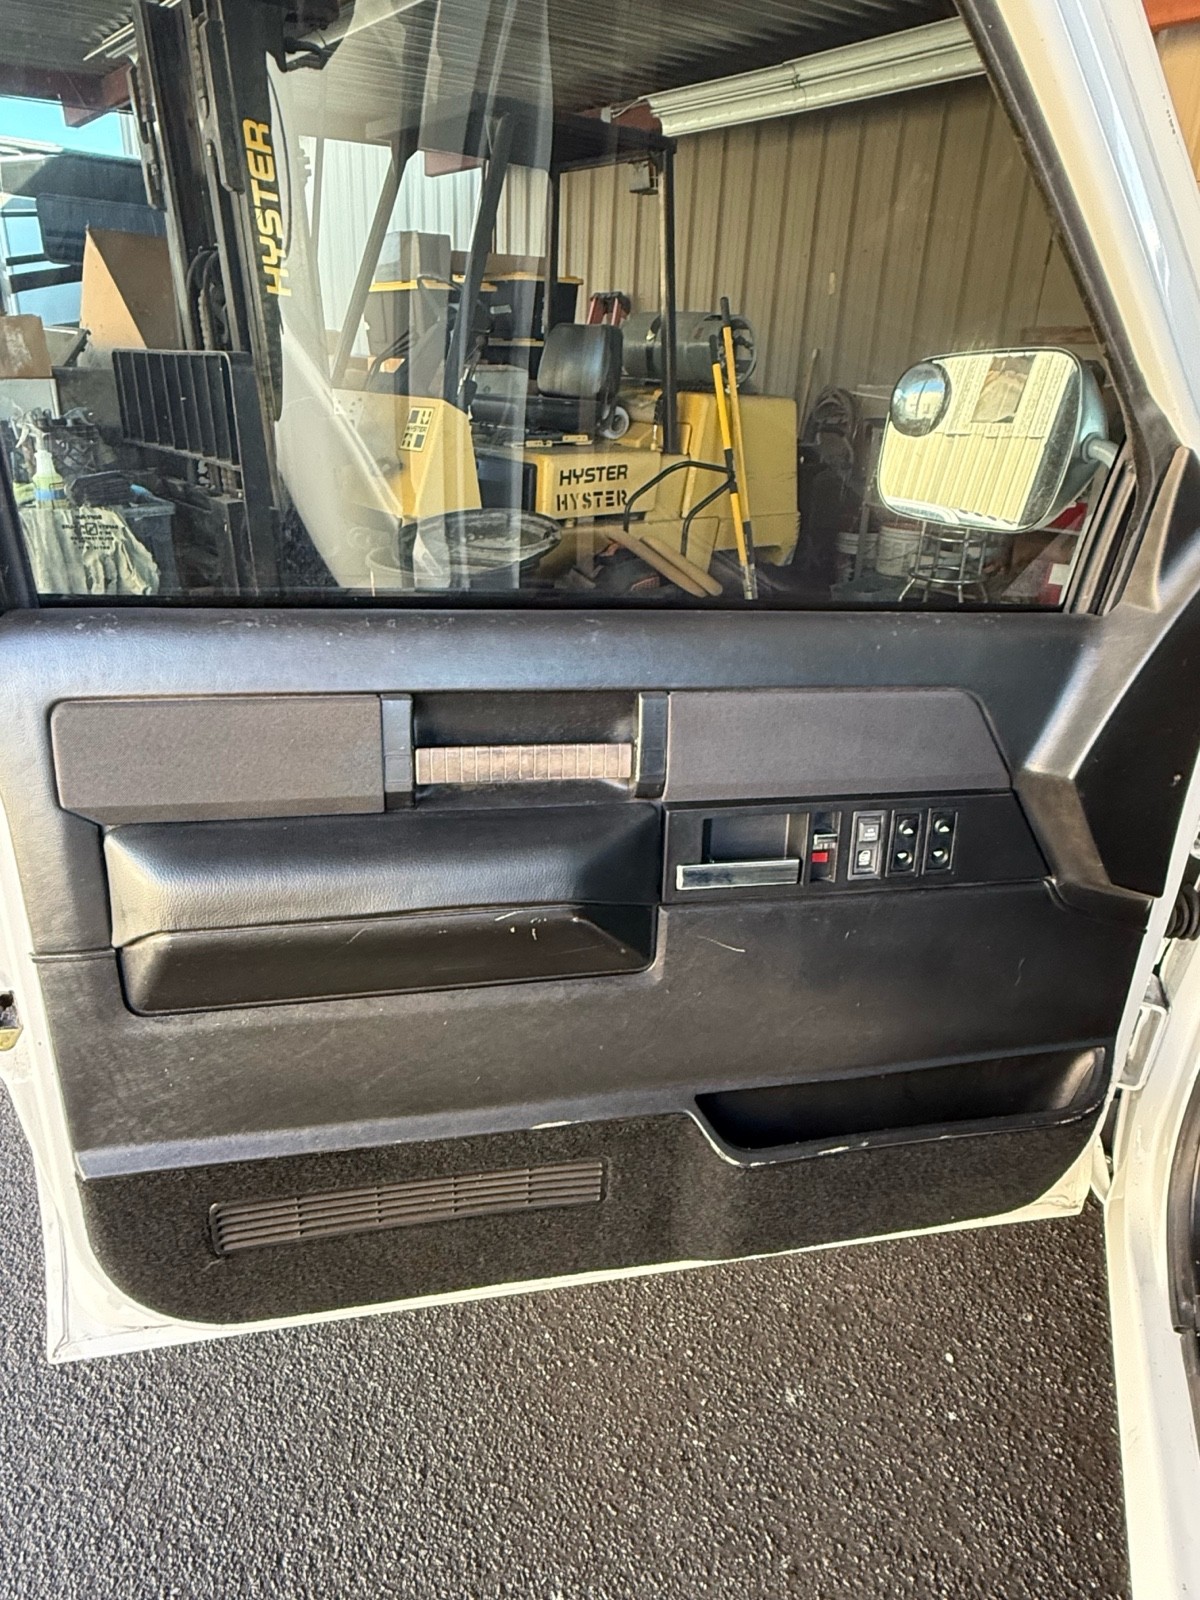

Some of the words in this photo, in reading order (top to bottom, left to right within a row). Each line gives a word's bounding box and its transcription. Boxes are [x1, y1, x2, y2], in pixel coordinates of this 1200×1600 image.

[242, 118, 292, 297] HYSTER
[559, 464, 628, 486] HYSTER
[556, 489, 628, 512] HYSTER
